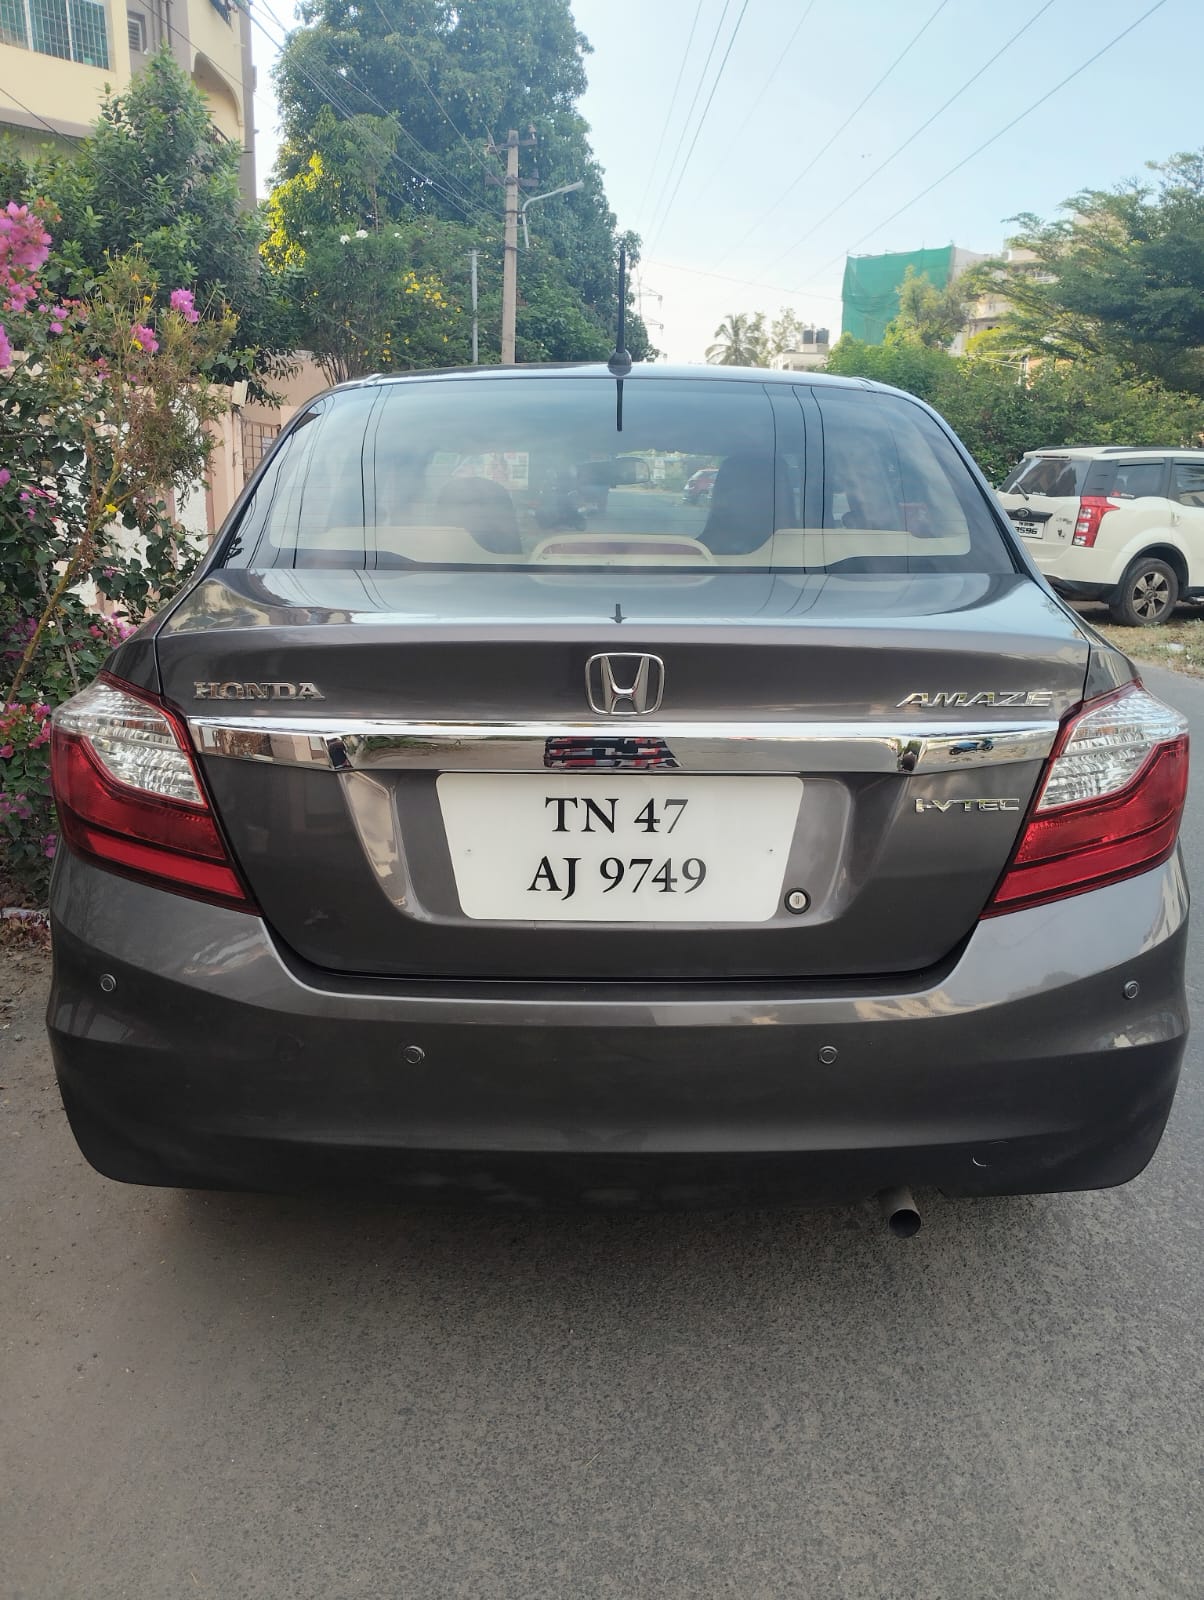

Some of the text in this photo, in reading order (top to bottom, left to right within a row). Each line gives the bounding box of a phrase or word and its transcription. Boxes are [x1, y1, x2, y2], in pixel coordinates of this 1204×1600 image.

[193, 681, 326, 700] HONDA
[896, 691, 1053, 707] AMAZE
[545, 797, 689, 833] TN 47
[527, 856, 707, 900] AJ 9749
